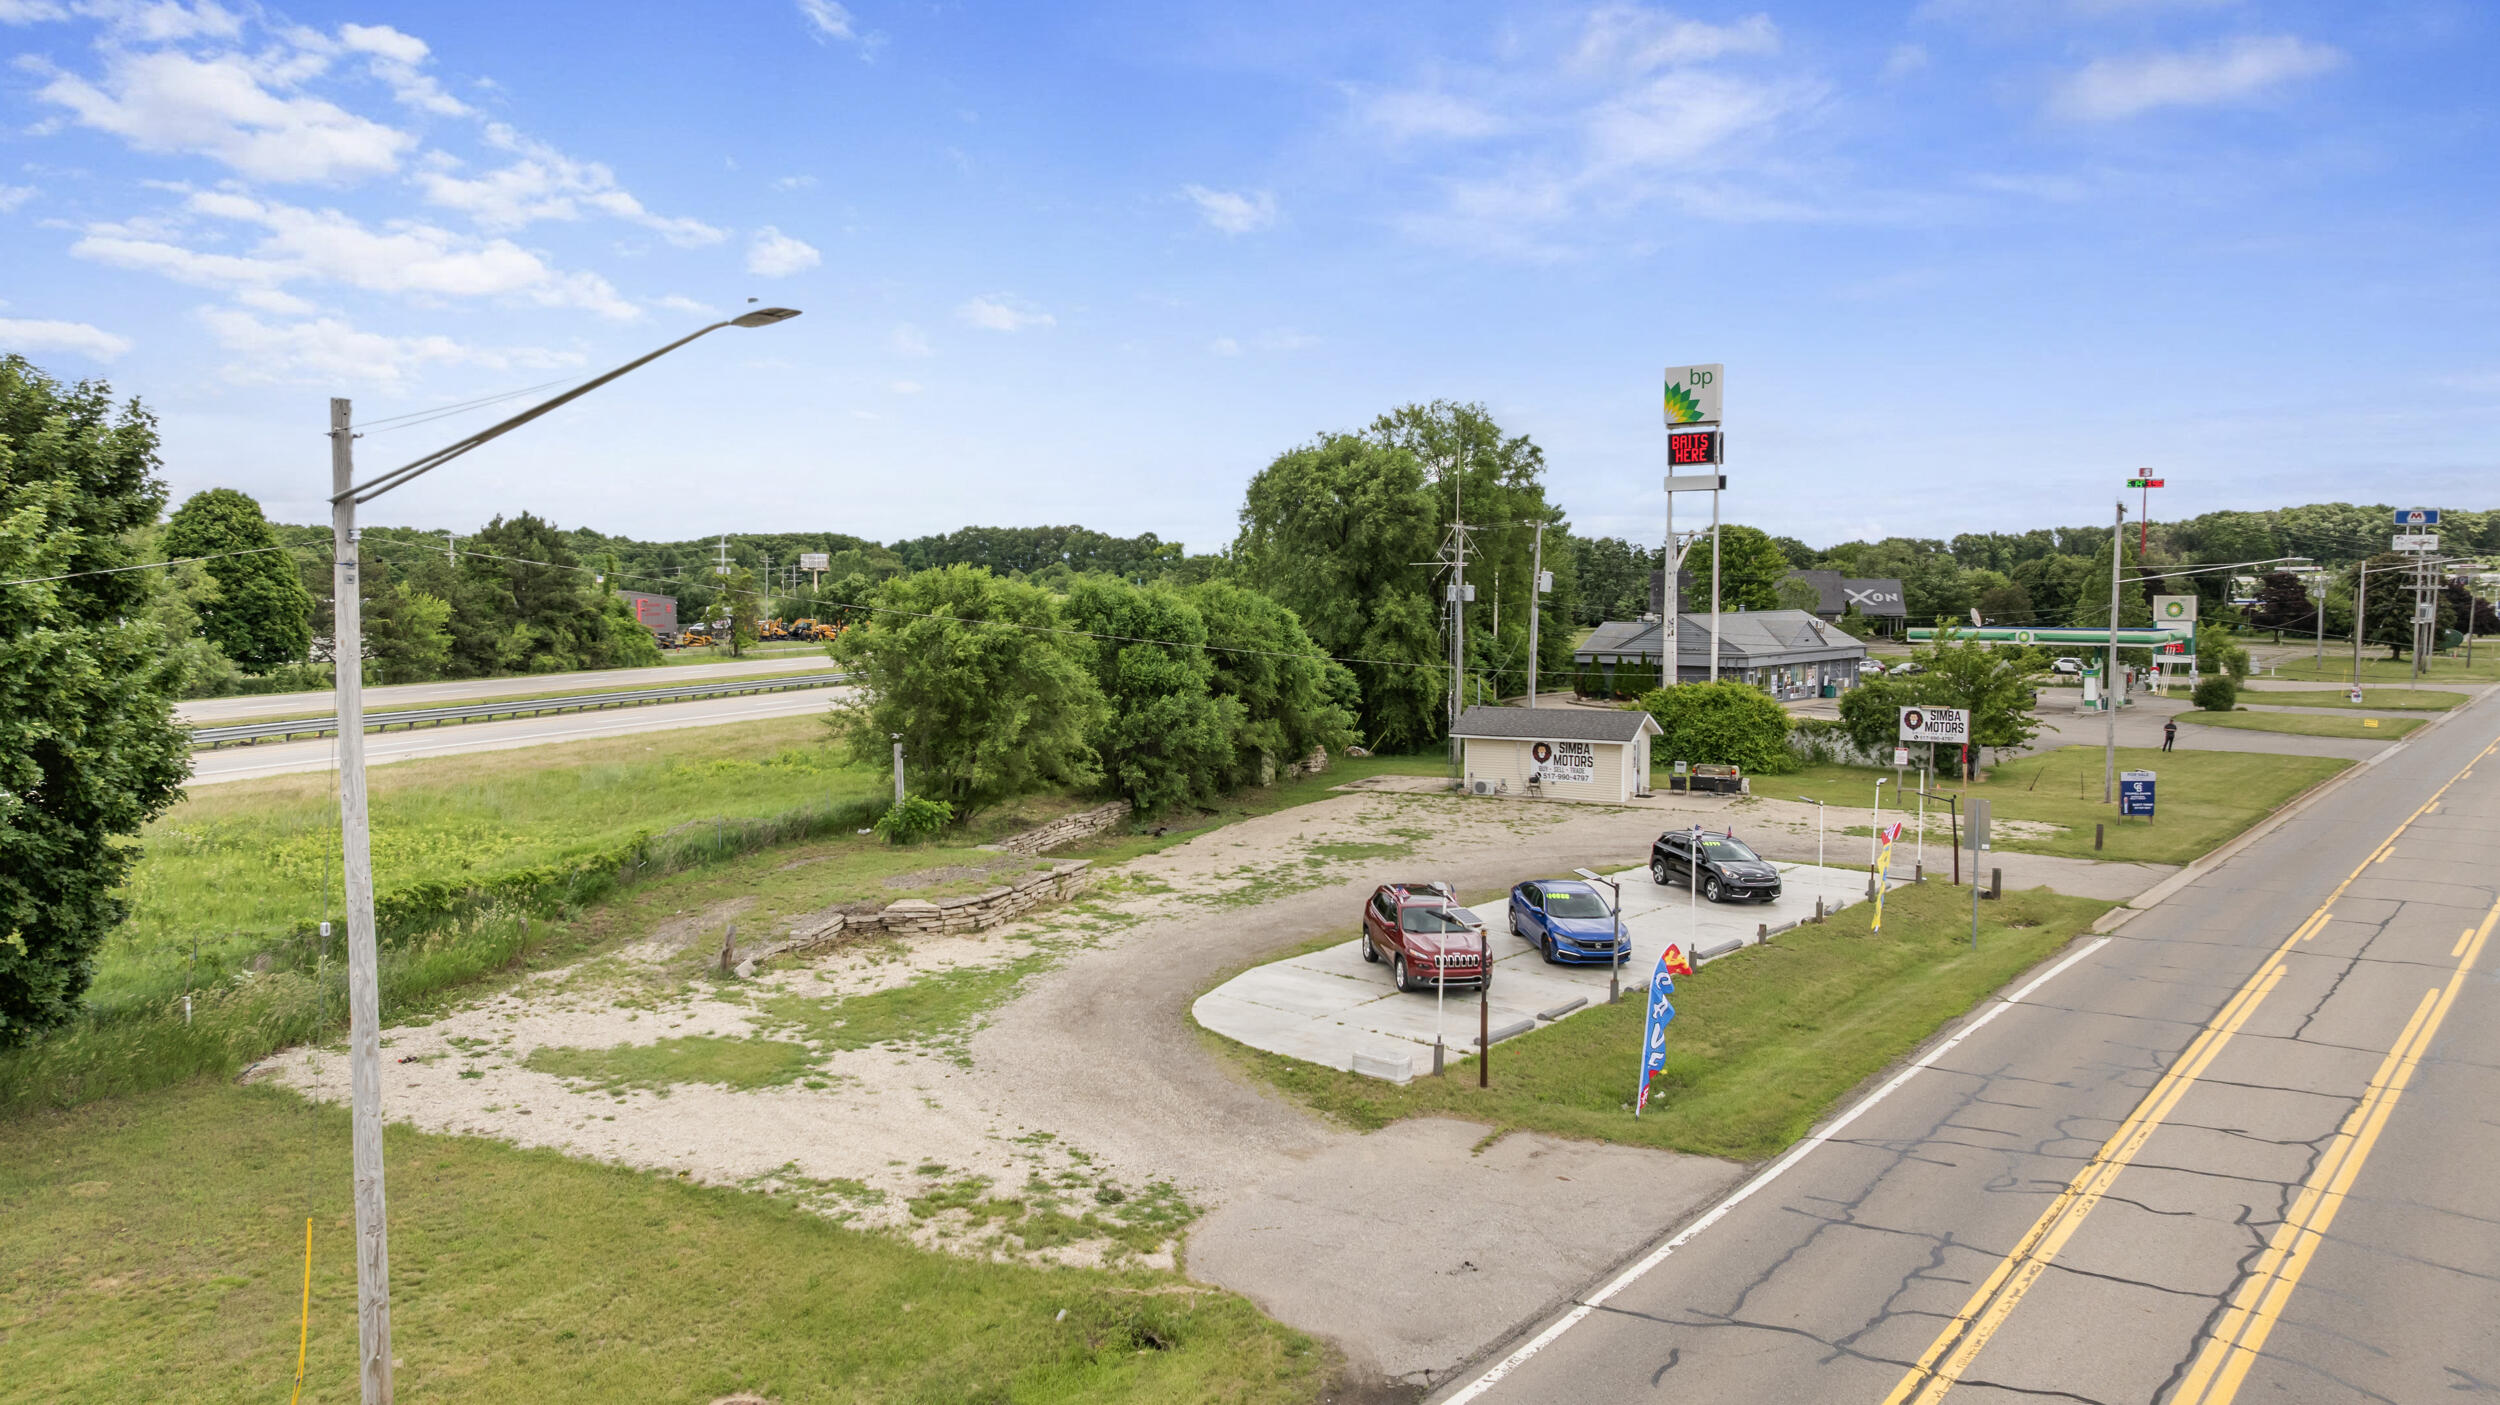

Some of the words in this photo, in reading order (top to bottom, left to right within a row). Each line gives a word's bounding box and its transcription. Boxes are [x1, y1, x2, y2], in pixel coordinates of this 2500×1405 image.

[1690, 368, 1713, 389] bp
[1671, 434, 1709, 450] BAITS
[1675, 448, 1708, 463] HERE
[1843, 588, 1899, 605] XON
[1930, 710, 1961, 721] SIMBA
[1925, 721, 1964, 733] MOTORS
[1559, 742, 1590, 755] SIMBA
[1553, 754, 1594, 767] MOTORS
